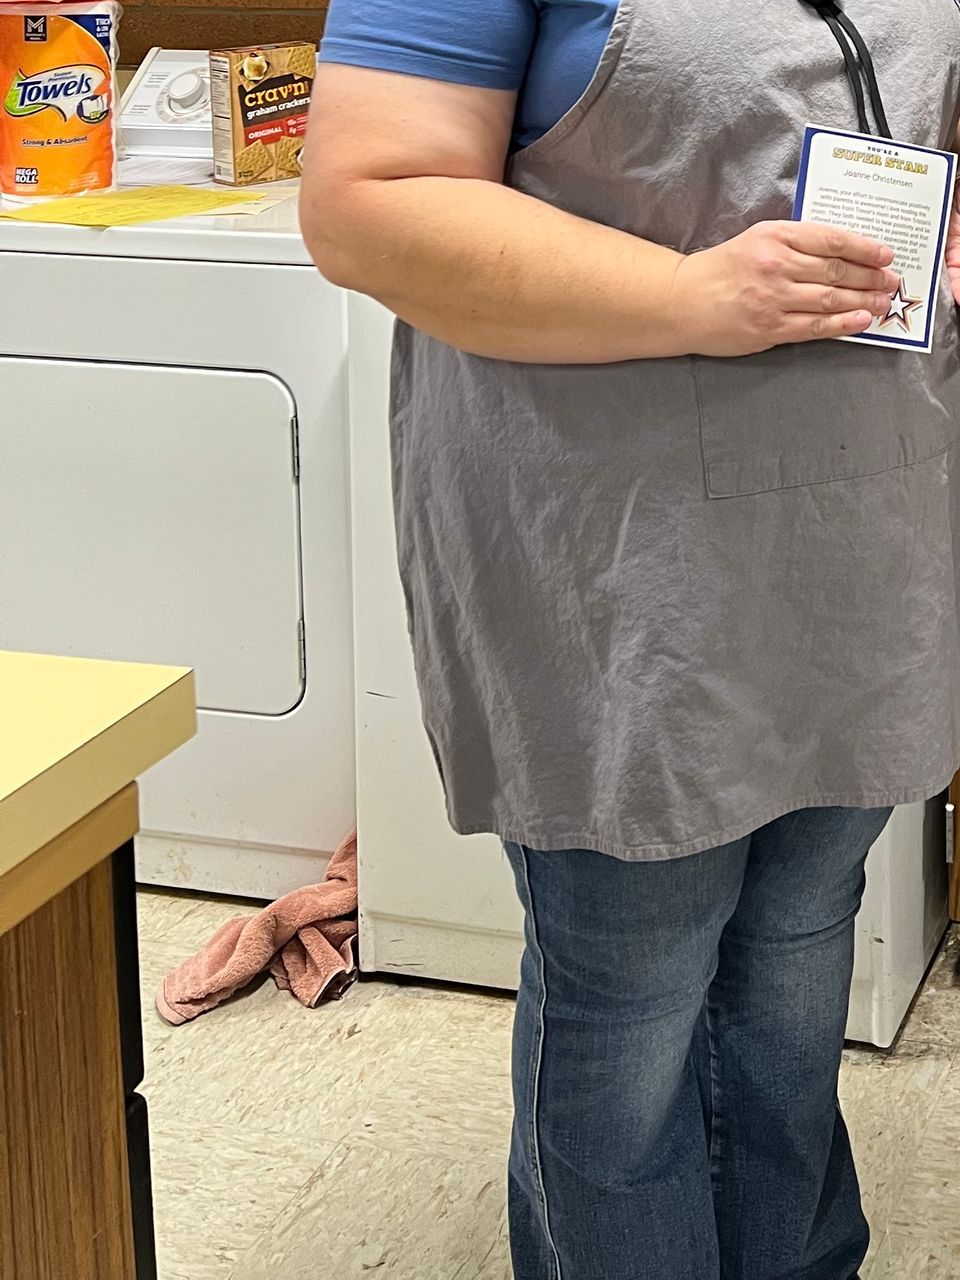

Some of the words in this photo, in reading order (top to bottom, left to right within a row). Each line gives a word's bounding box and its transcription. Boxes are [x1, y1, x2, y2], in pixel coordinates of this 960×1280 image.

[17, 73, 92, 106] Towels
[244, 81, 305, 107] crav'n
[246, 104, 278, 120] graham
[248, 126, 282, 140] ORIGINAL
[22, 138, 44, 146] Strong
[54, 136, 87, 145] Absorbent
[832, 147, 882, 166] SUPER
[884, 157, 928, 175] STAR!
[15, 175, 37, 183] ROLL
[16, 168, 37, 176] MEGA
[872, 173, 913, 188] Christensen
